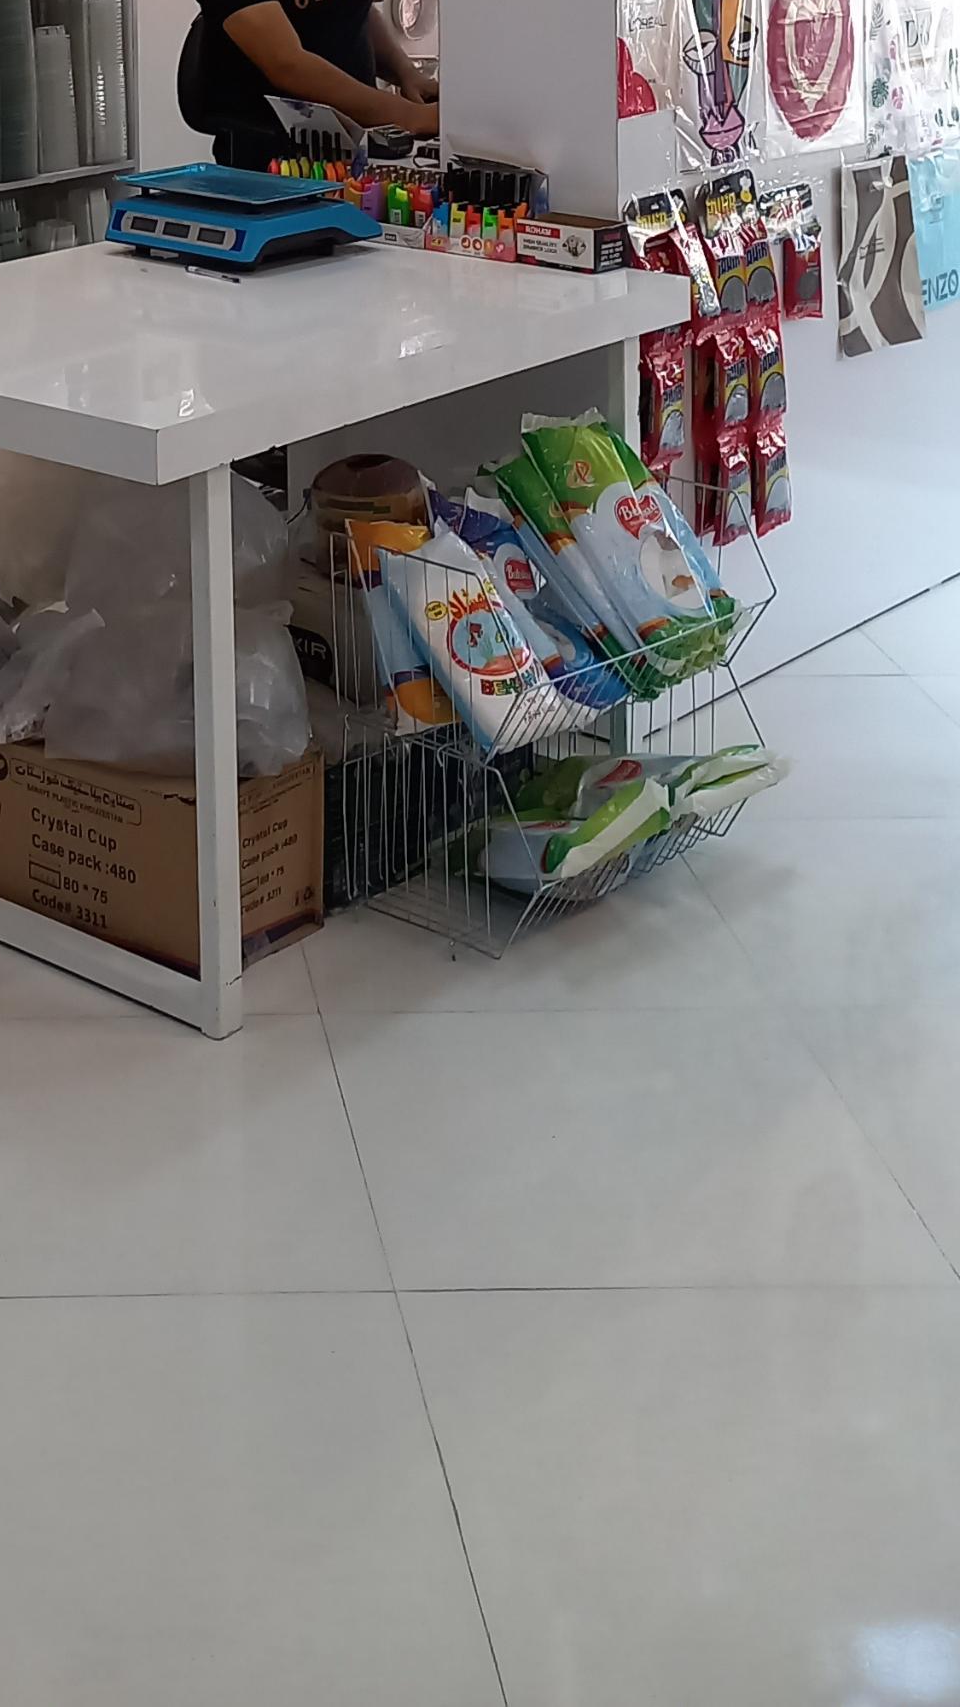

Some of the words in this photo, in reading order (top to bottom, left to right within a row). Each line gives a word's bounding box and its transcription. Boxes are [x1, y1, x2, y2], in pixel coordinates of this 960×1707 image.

[921, 268, 959, 306] ENZO
[31, 807, 83, 839] Crystal
[87, 828, 118, 853] Cup
[31, 833, 65, 858] Case
[68, 850, 102, 873] pack
[105, 863, 137, 884] :480
[32, 888, 72, 914] Code#
[76, 905, 108, 929] 3311
[62, 875, 80, 894] 80
[91, 886, 109, 905] 75
